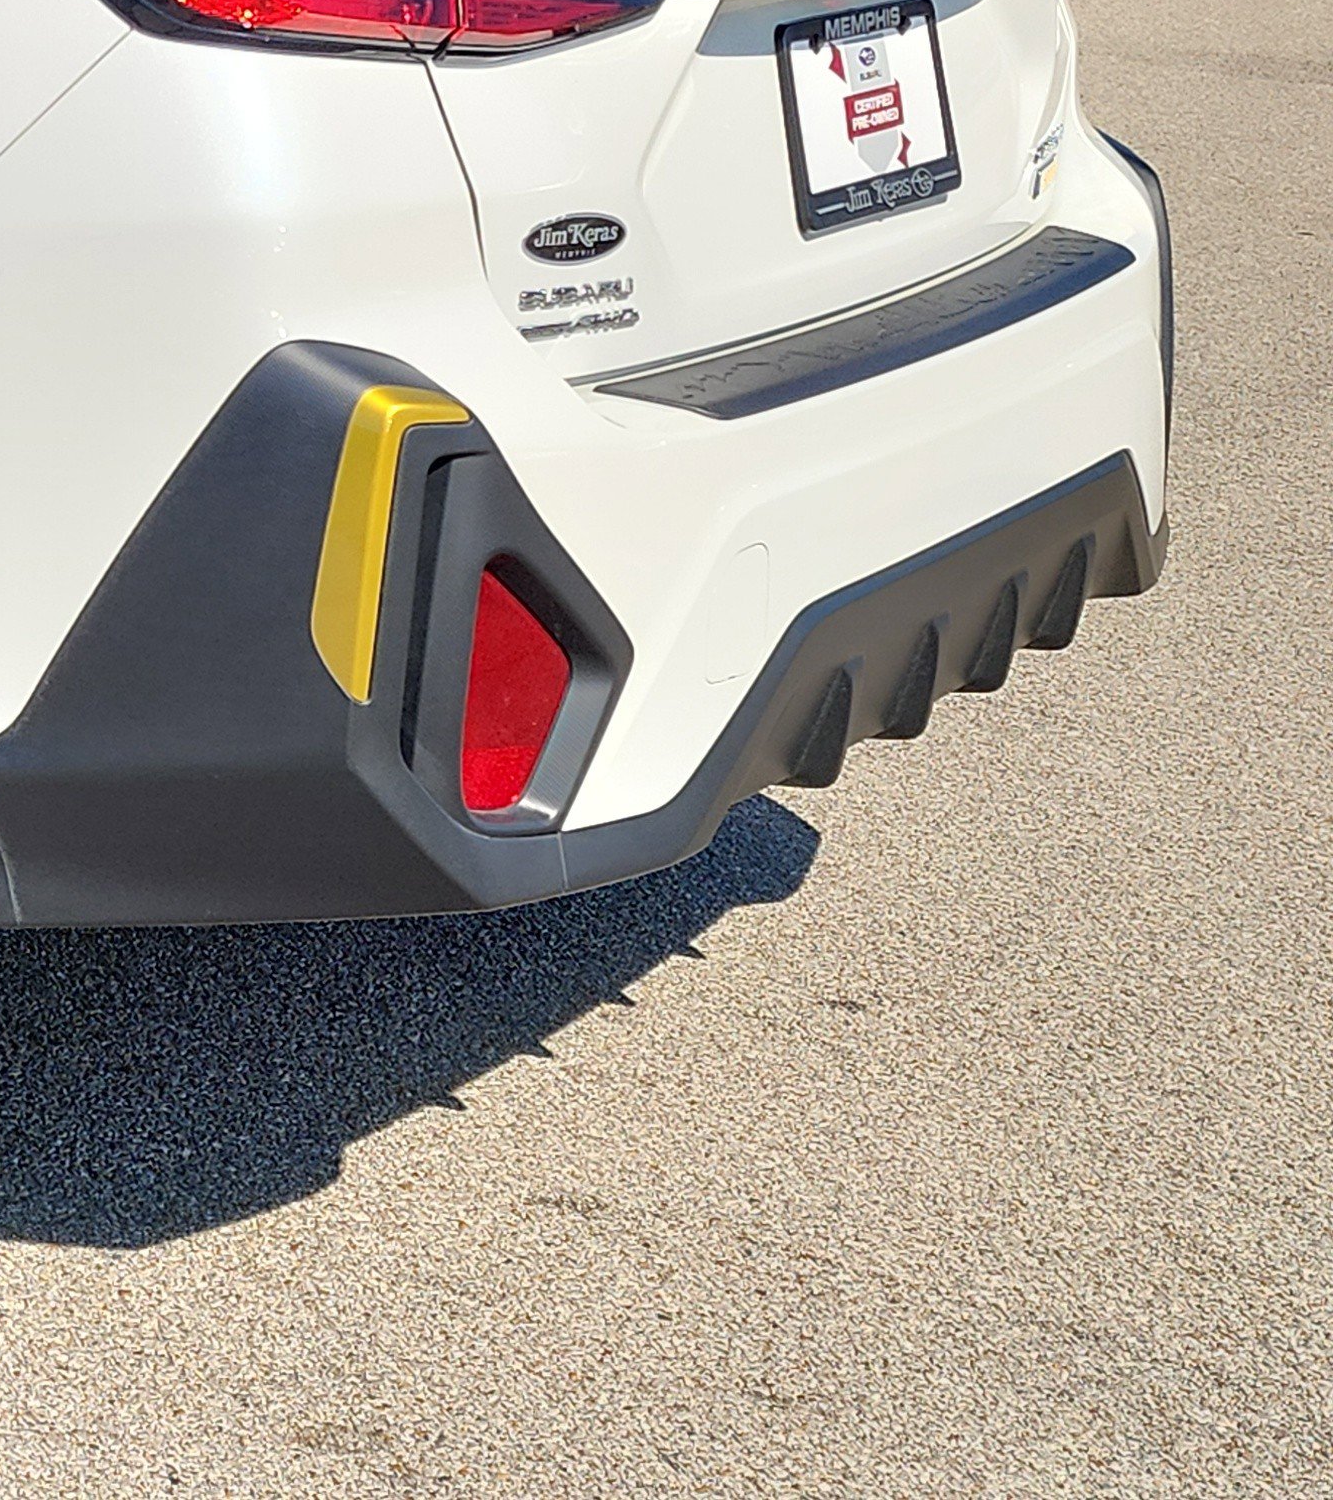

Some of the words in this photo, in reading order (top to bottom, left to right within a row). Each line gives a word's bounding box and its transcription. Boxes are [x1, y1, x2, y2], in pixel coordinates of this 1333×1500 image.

[824, 6, 902, 41] MEMPHIS
[845, 186, 873, 214] Jim
[871, 177, 913, 209] Keras
[533, 226, 568, 248] Jim
[568, 222, 620, 248] Keras
[518, 276, 634, 313] SUBARU
